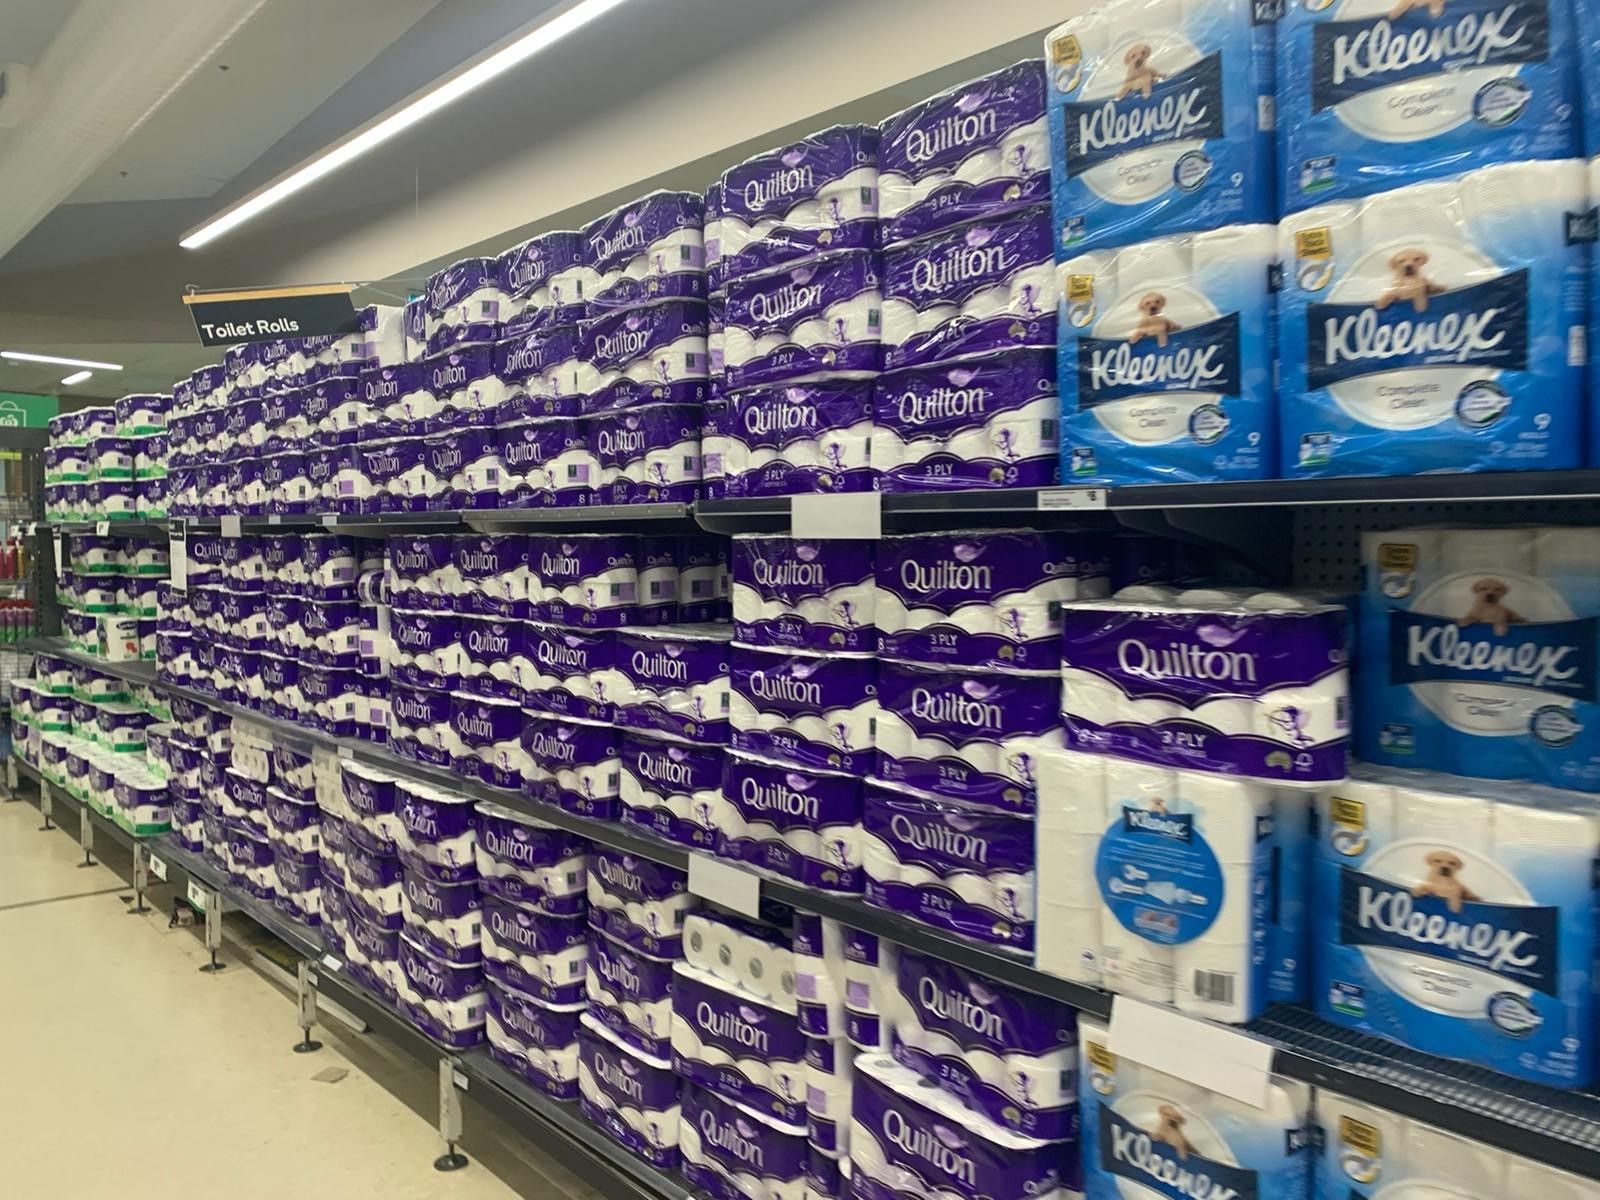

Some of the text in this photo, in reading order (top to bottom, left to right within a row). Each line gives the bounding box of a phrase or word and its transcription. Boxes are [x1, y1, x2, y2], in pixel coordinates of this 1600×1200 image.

[1333, 4, 1528, 85] Kleenex
[905, 108, 997, 163] Quilton
[1079, 87, 1207, 155] Kleenex
[744, 165, 814, 211] Quilton
[1231, 172, 1244, 188] 9
[882, 226, 890, 239] 8
[508, 259, 546, 289] Quilton
[911, 244, 1006, 293] Quilton
[750, 284, 825, 322] Quilton
[201, 318, 300, 339] Toilet Rolls
[1325, 308, 1506, 364] Kleenex
[594, 330, 651, 359] Quilton
[771, 352, 795, 366] 3 PLY
[885, 352, 892, 365] 8
[433, 365, 466, 389] Quilton
[1091, 343, 1225, 390] Kleenex
[365, 380, 398, 401] Quilton
[744, 405, 818, 435] Quilton
[898, 387, 986, 425] Quilton
[1533, 413, 1551, 431] 9
[504, 441, 542, 464] Quilton
[598, 430, 646, 456] Quilton
[1247, 431, 1262, 446] 9
[432, 449, 462, 471] Quilton
[926, 464, 954, 476] 3 PLY
[194, 542, 222, 558] Quilt
[460, 549, 498, 571] Quilton
[541, 552, 580, 577] Quilton
[753, 558, 824, 588] Quilton
[901, 559, 992, 593] Quilton
[469, 630, 509, 654] Quilton
[538, 639, 587, 668] Quilton
[878, 638, 886, 650] 8
[930, 634, 959, 646] 3 PLY
[1407, 623, 1580, 687] Kleenex
[632, 650, 688, 680] Quilton
[1118, 639, 1257, 682] Quilton
[750, 670, 821, 704] Quilton
[396, 697, 431, 721] Quilton
[911, 688, 1003, 729] Quilton
[457, 712, 494, 738] Quilton
[1161, 730, 1207, 748] 3 PLY
[532, 732, 576, 761] Quilton
[638, 751, 693, 786] Quilton
[938, 765, 969, 782] 3 PLY
[742, 777, 820, 819] Quilton
[486, 831, 534, 865] Quilton
[891, 814, 988, 864] Quilton
[599, 856, 642, 896] Quilton
[921, 893, 951, 910] 3 PLY
[492, 911, 537, 950] Quilton
[1358, 886, 1540, 969] Kleenex
[599, 951, 640, 994] Quilton
[919, 976, 1005, 1042] Quilton
[696, 1001, 769, 1052] Quilton
[594, 1052, 643, 1102] Quilton
[700, 1109, 764, 1168] Quilton
[883, 1109, 977, 1187] Quilton
